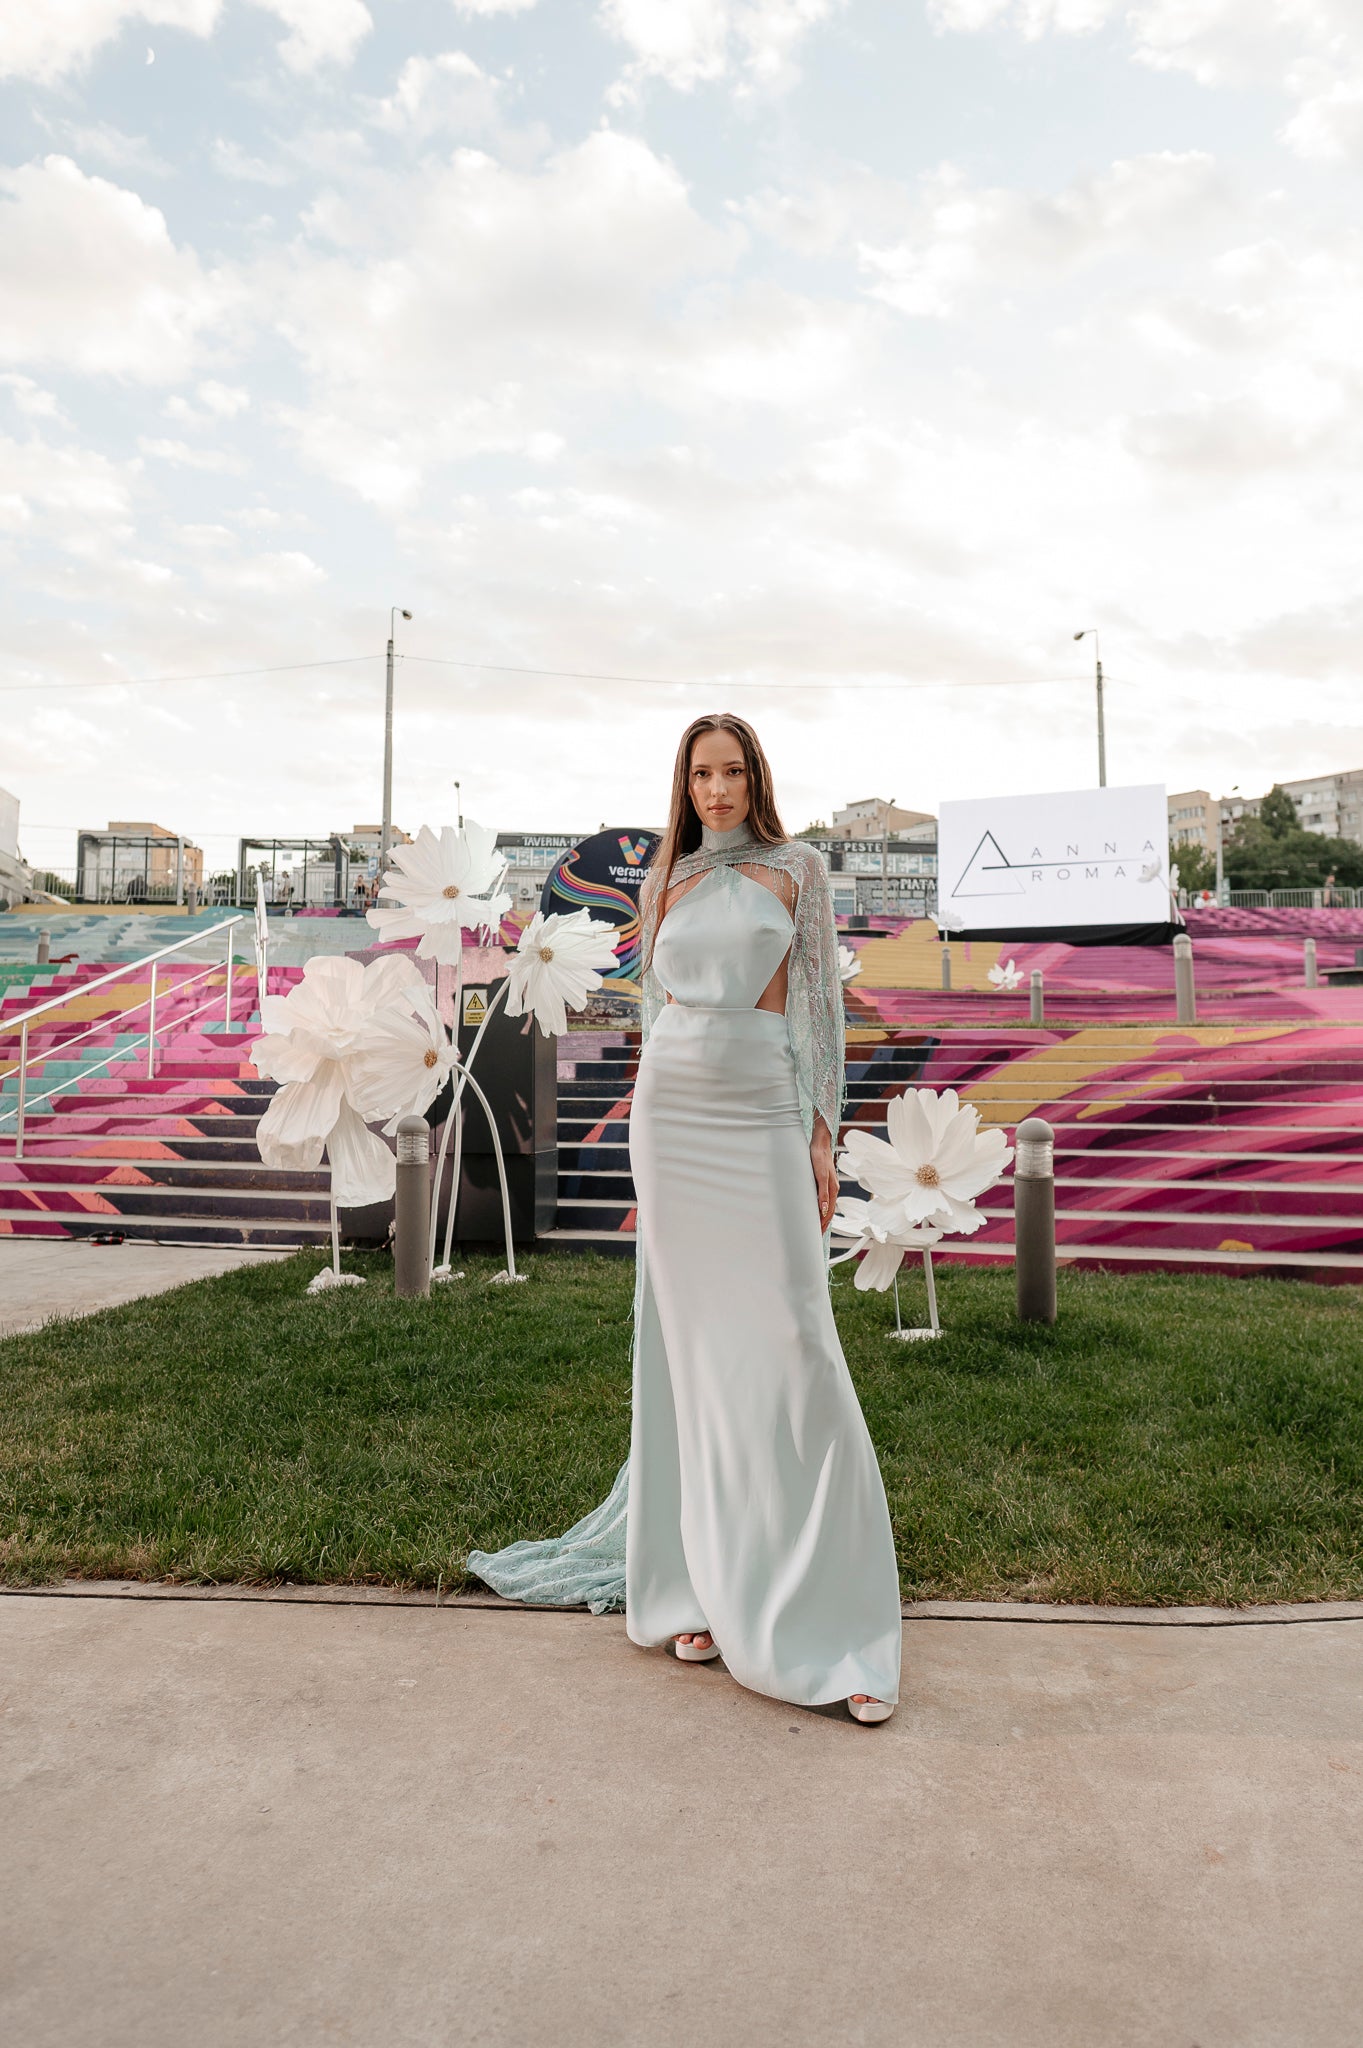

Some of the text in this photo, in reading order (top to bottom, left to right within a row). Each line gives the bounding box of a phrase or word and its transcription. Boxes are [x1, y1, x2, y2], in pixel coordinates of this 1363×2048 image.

[522, 836, 567, 847] TAVERNA
[820, 842, 882, 852] DE PESTE
[1031, 840, 1154, 858] ANNA
[608, 866, 652, 878] verand
[900, 878, 936, 890] PIATA
